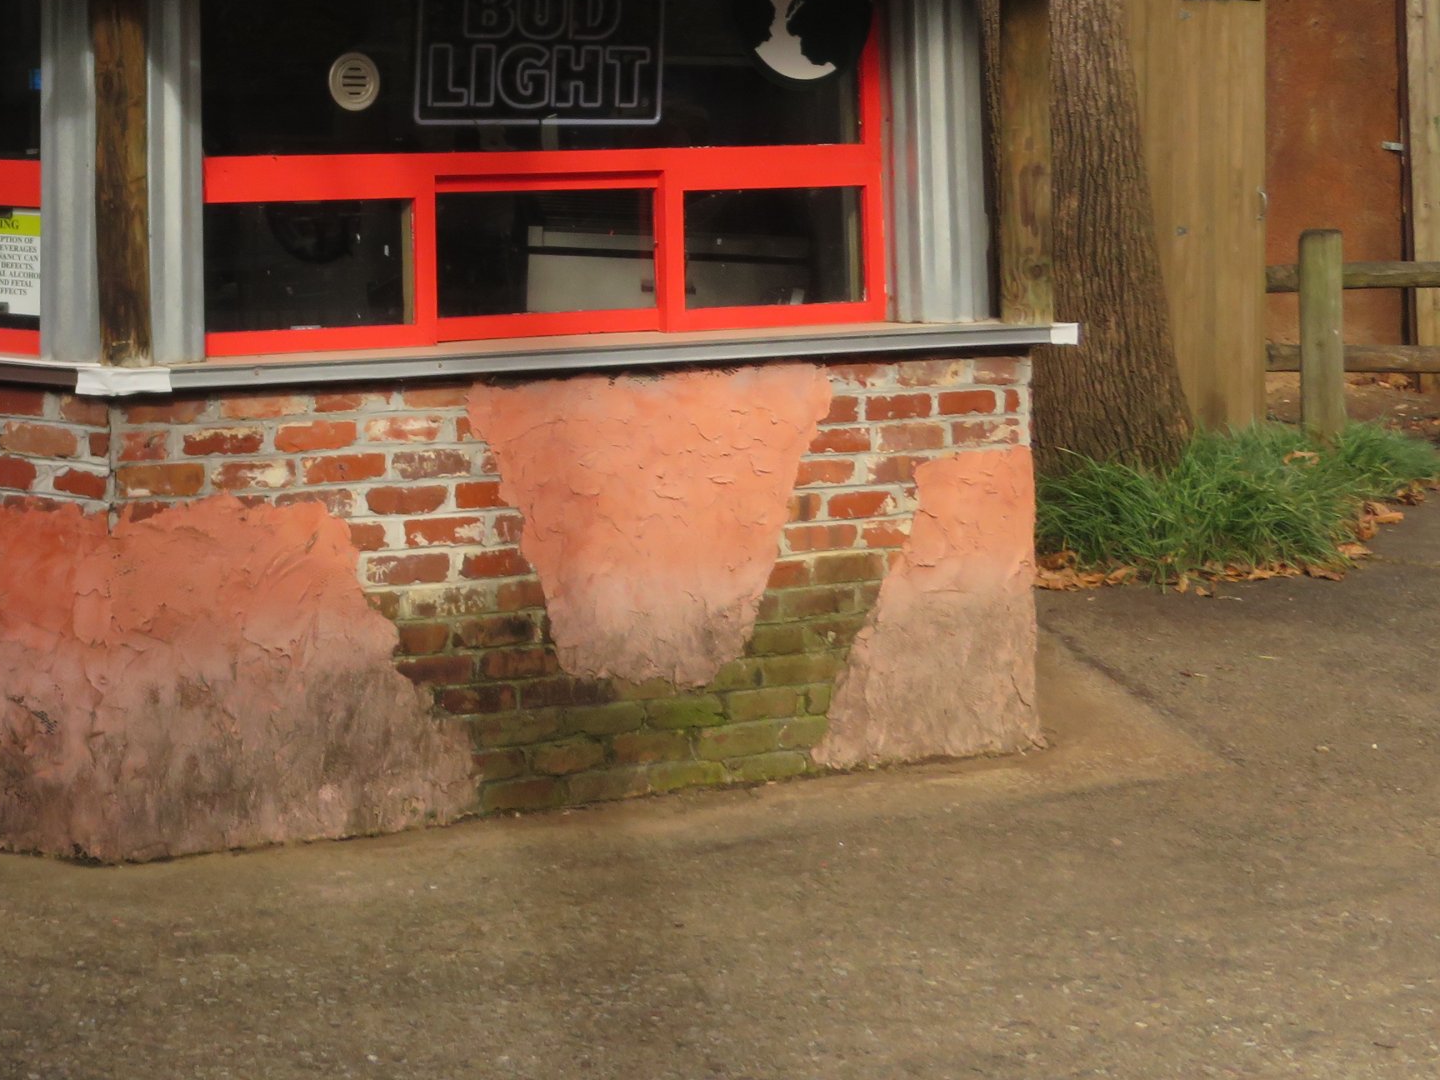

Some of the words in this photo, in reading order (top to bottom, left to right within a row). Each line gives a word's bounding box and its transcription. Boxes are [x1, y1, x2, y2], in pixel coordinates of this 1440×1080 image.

[427, 43, 651, 109] LIGHT
[23, 254, 39, 262] CAN
[11, 280, 33, 288] FETAL
